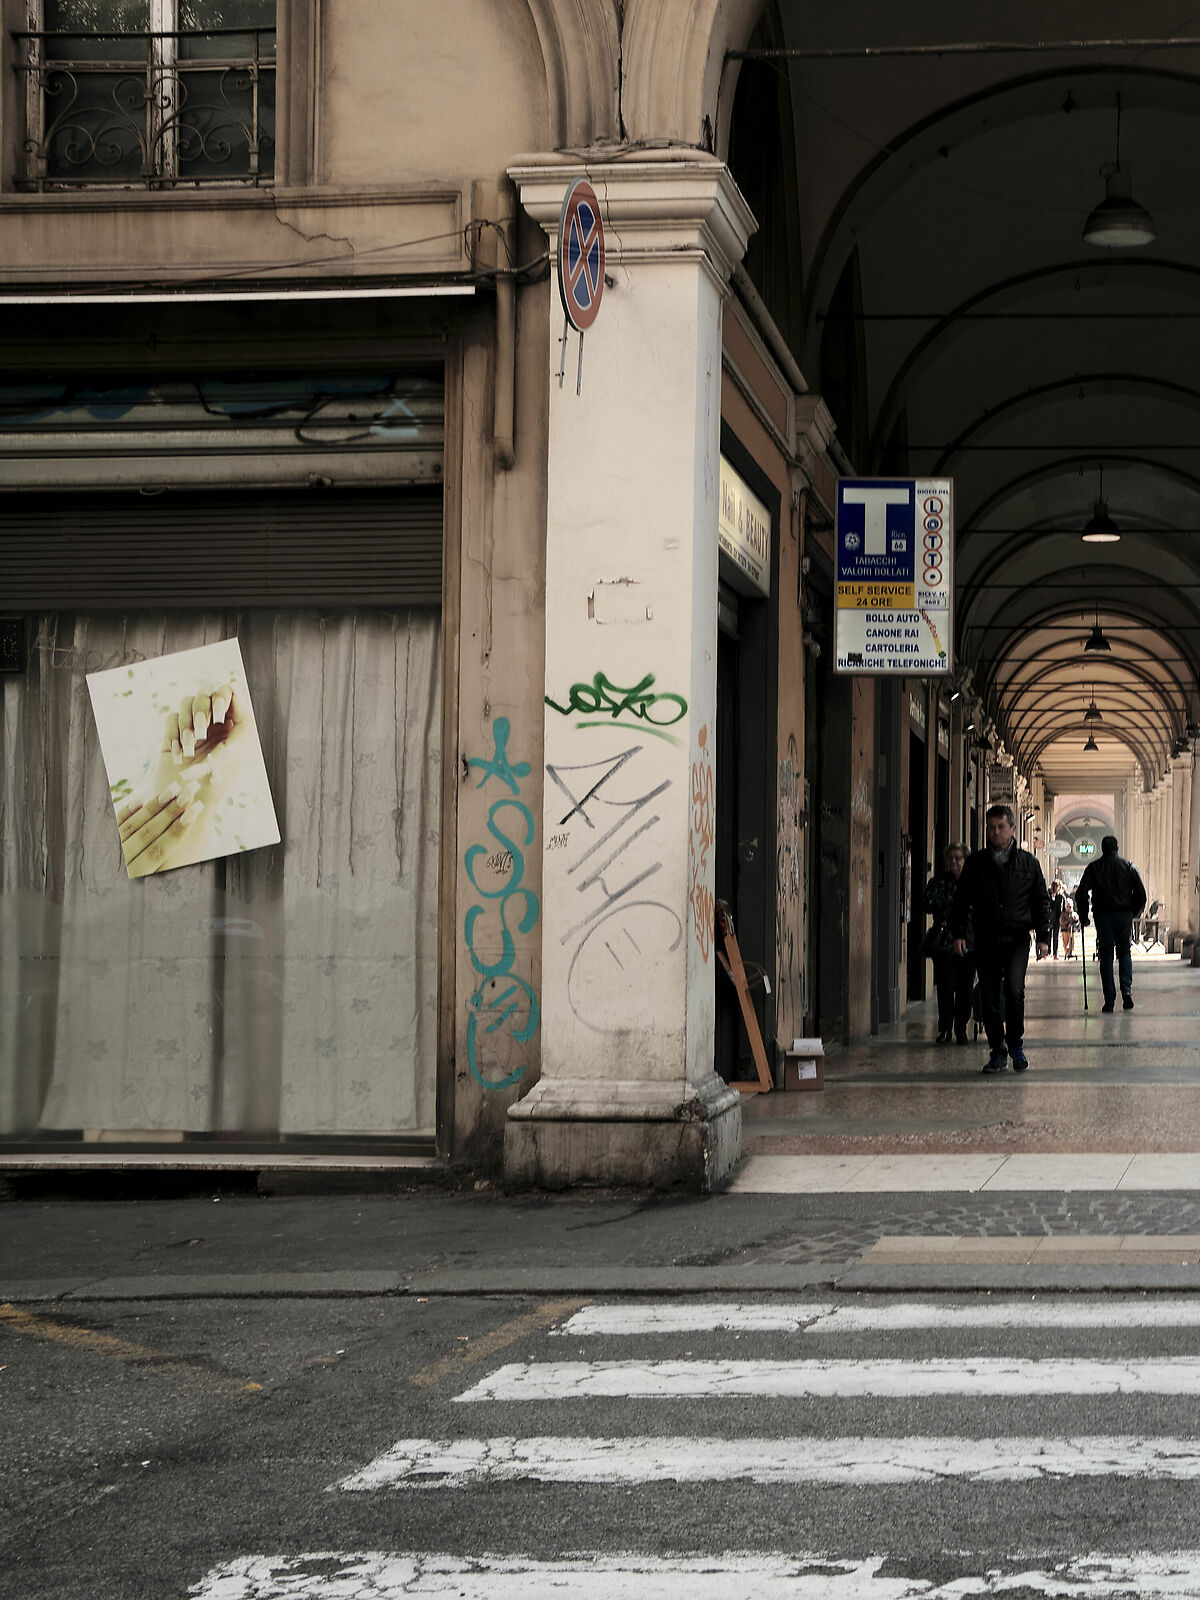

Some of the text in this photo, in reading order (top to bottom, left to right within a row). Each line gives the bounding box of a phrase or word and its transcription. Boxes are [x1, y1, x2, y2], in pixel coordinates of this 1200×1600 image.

[843, 488, 910, 555] T
[746, 507, 769, 562] BEAUTY
[894, 541, 904, 550] 66
[855, 556, 897, 566] TABACCHI
[842, 567, 909, 577] VALORI BOLLATI
[838, 586, 912, 596] SELF SERVICE
[856, 597, 893, 607] 24 ORE
[865, 614, 920, 623] BOLLO AUTO
[866, 629, 919, 638] CANONE RAI
[865, 644, 920, 653] CARTOLERIA
[838, 659, 947, 669] RICARICHE TELEFONICHE
